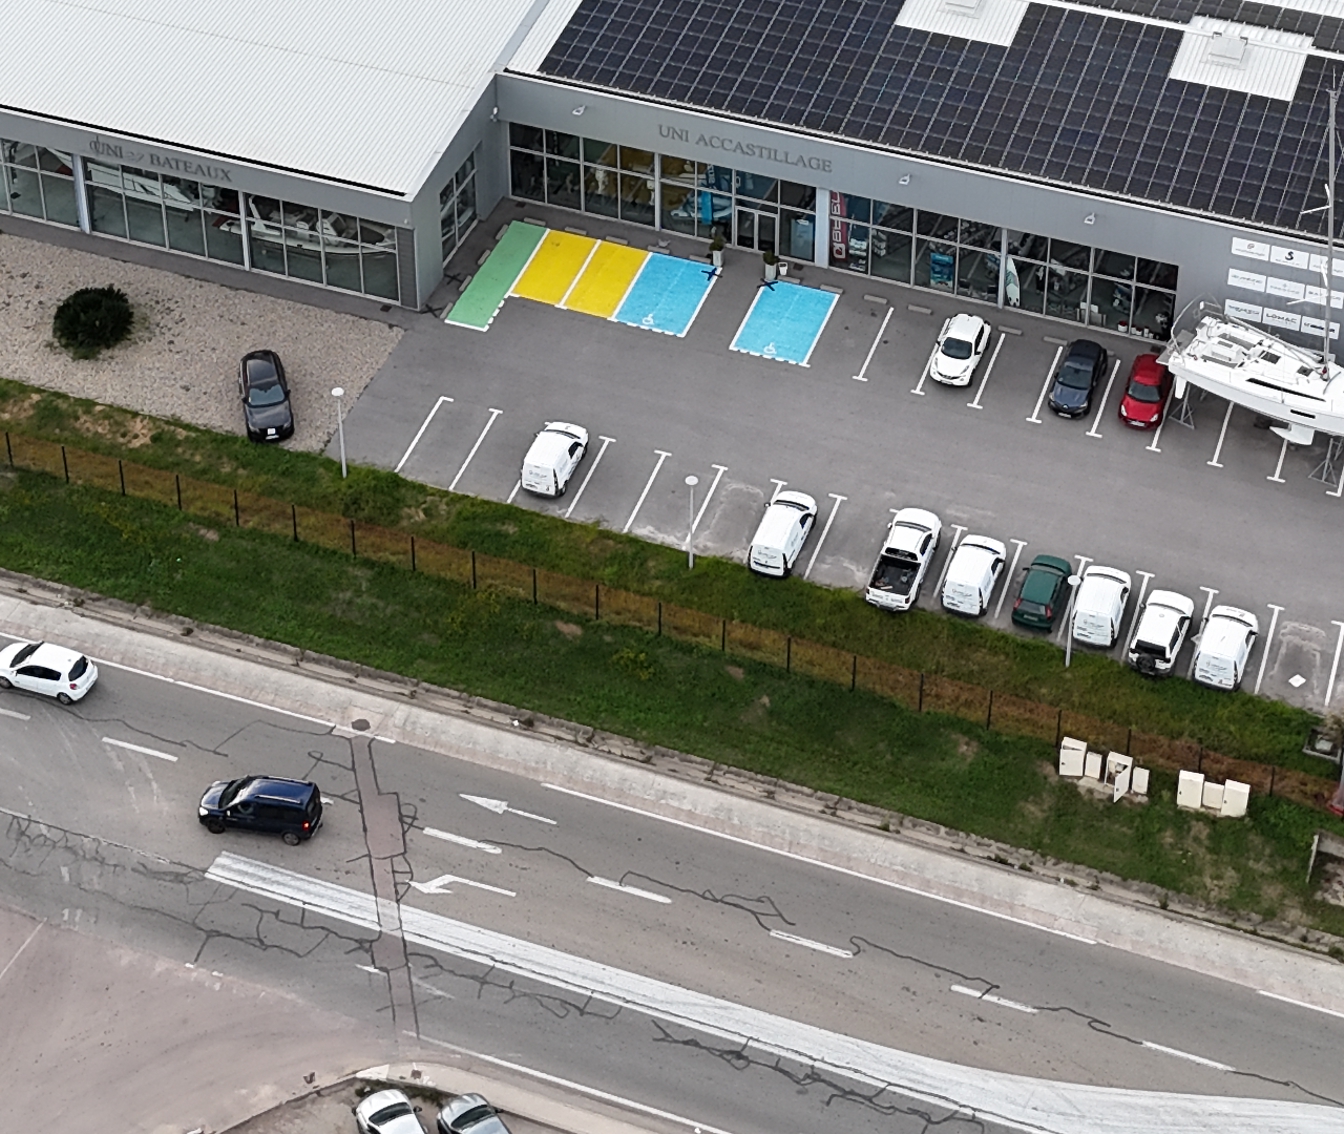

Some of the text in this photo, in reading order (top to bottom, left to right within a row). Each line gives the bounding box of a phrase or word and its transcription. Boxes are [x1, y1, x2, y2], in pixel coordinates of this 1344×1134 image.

[94, 142, 233, 183] UNI BATEAUX
[658, 123, 834, 174] UNI ACCASTILLAGE
